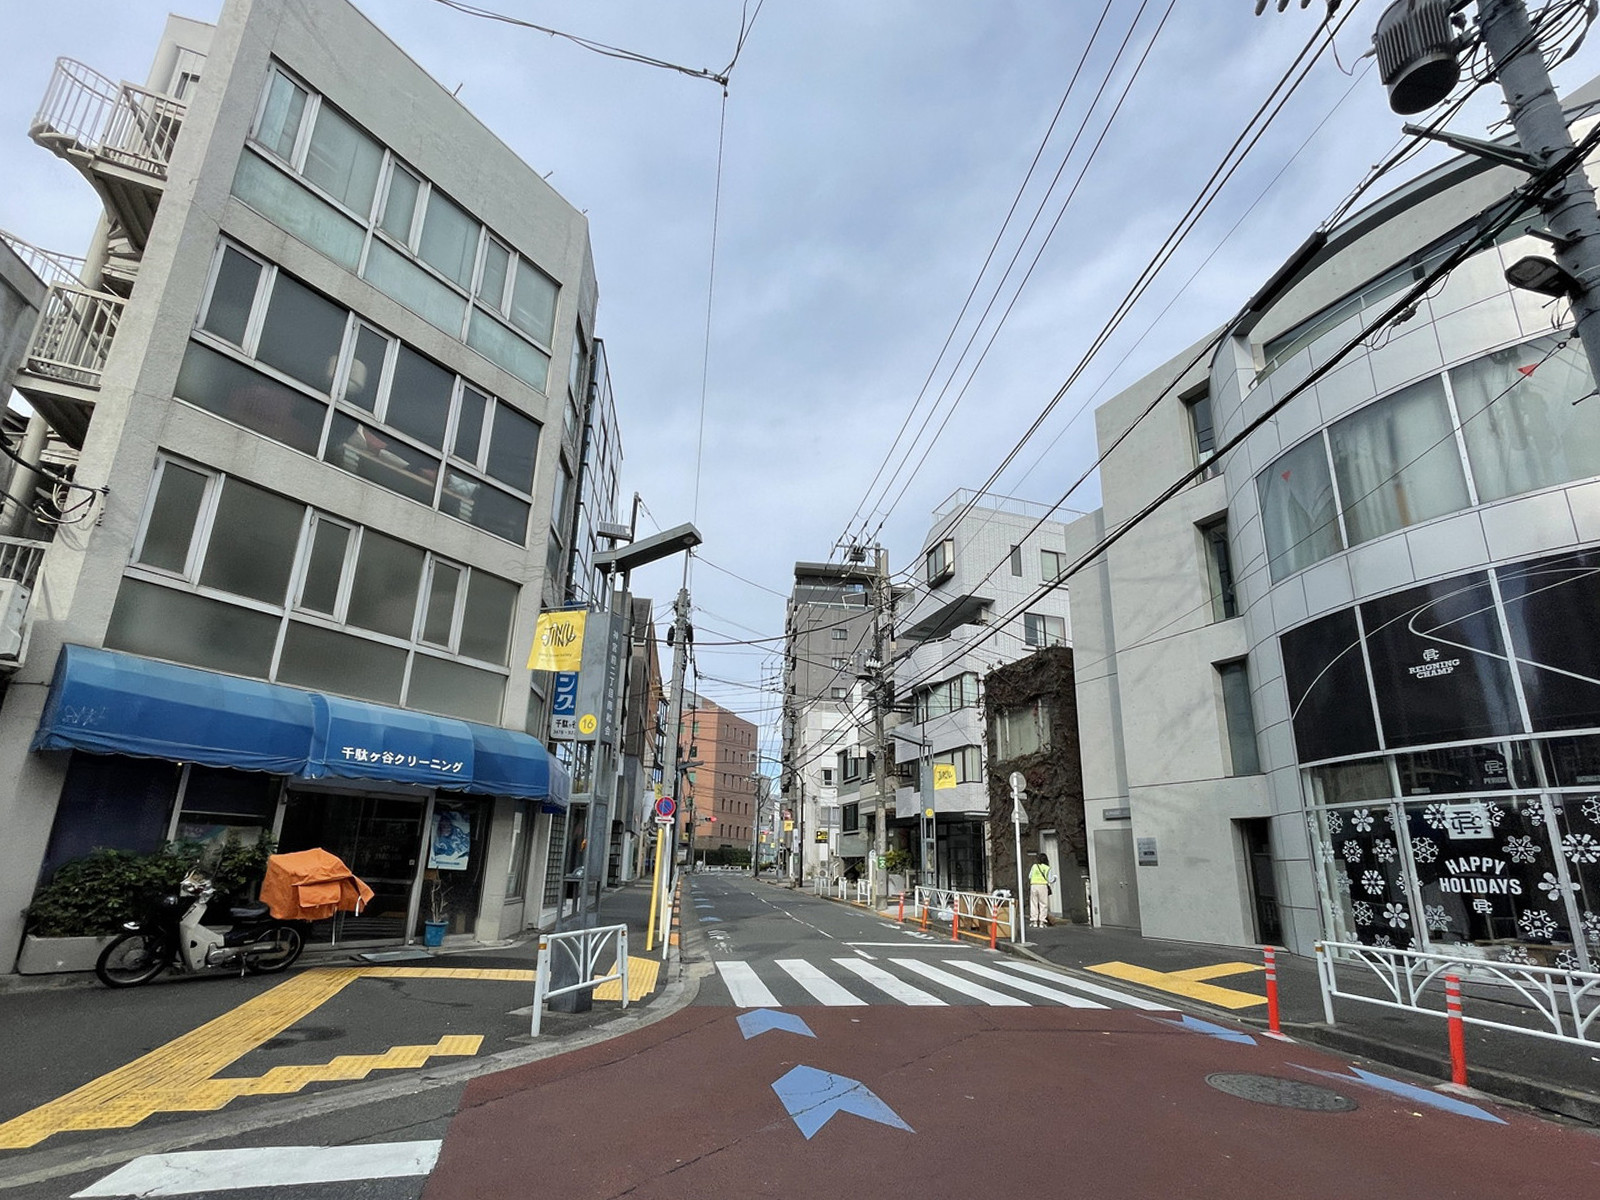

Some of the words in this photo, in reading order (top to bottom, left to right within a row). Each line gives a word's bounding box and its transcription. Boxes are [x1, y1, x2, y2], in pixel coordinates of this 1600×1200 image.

[1408, 658, 1461, 674] REIGNING
[1416, 666, 1454, 679] CHAMP
[582, 718, 595, 729] 16
[1445, 856, 1506, 875] HAPPY
[1439, 877, 1523, 895] HOLIDAYS
